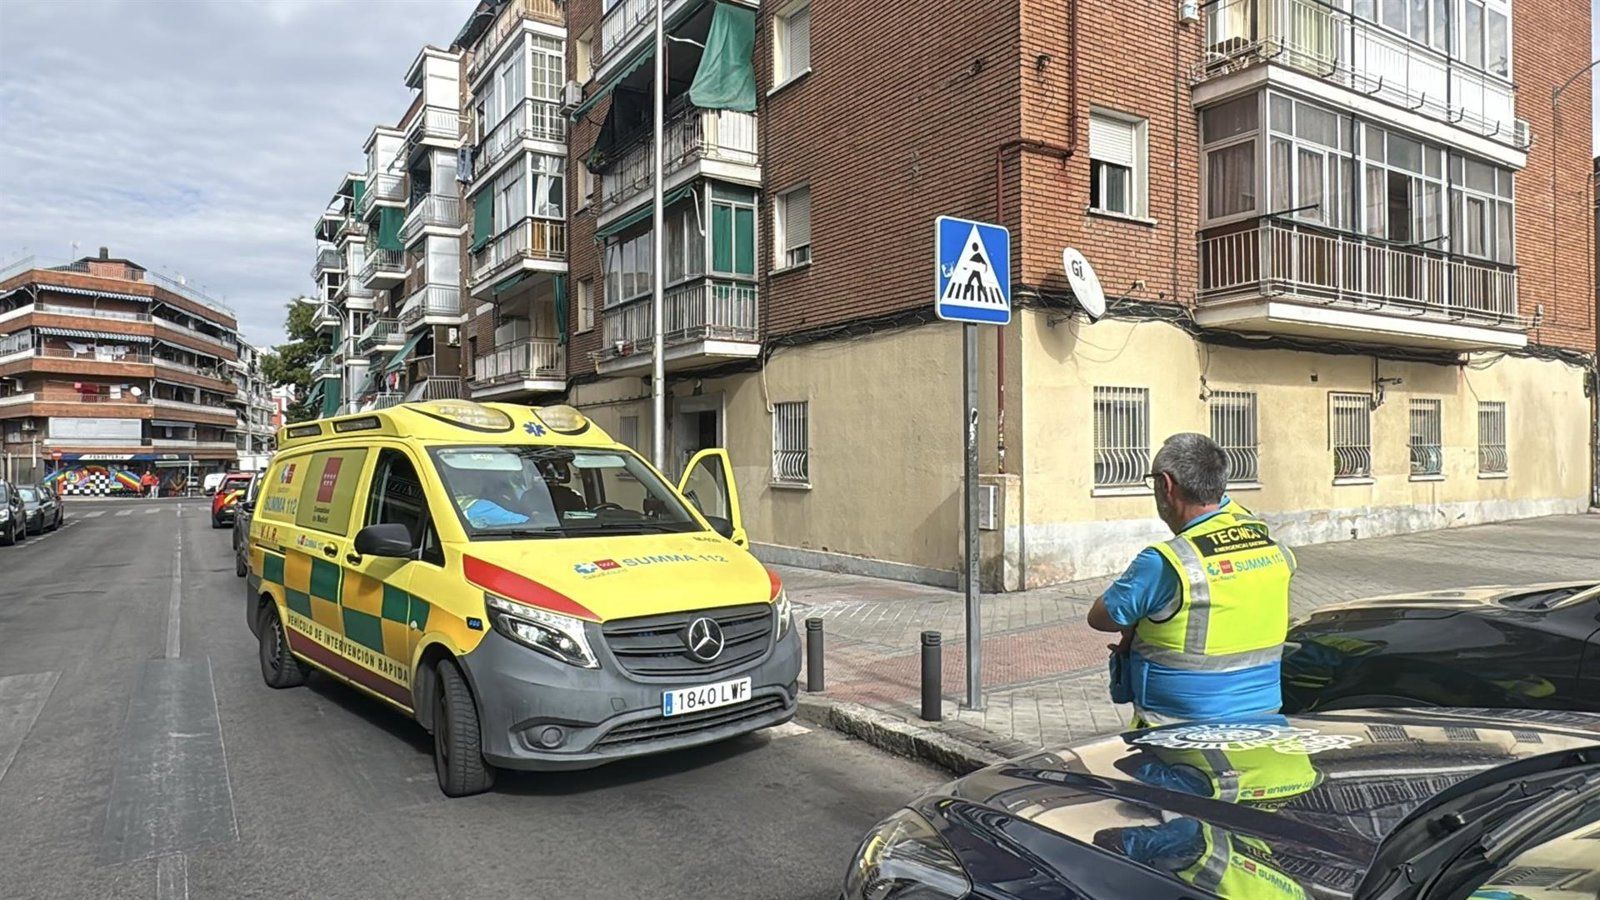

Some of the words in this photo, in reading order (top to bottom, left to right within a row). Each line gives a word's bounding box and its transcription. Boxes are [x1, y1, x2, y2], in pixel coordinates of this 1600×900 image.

[286, 496, 298, 515] 112
[623, 554, 698, 566] SUMMA
[699, 554, 728, 562] 112
[1236, 556, 1271, 571] SUMMA
[314, 627, 323, 641] DE
[324, 632, 375, 668] INTERVENCIÓN
[678, 687, 717, 711] 1840
[721, 680, 748, 703] LWF
